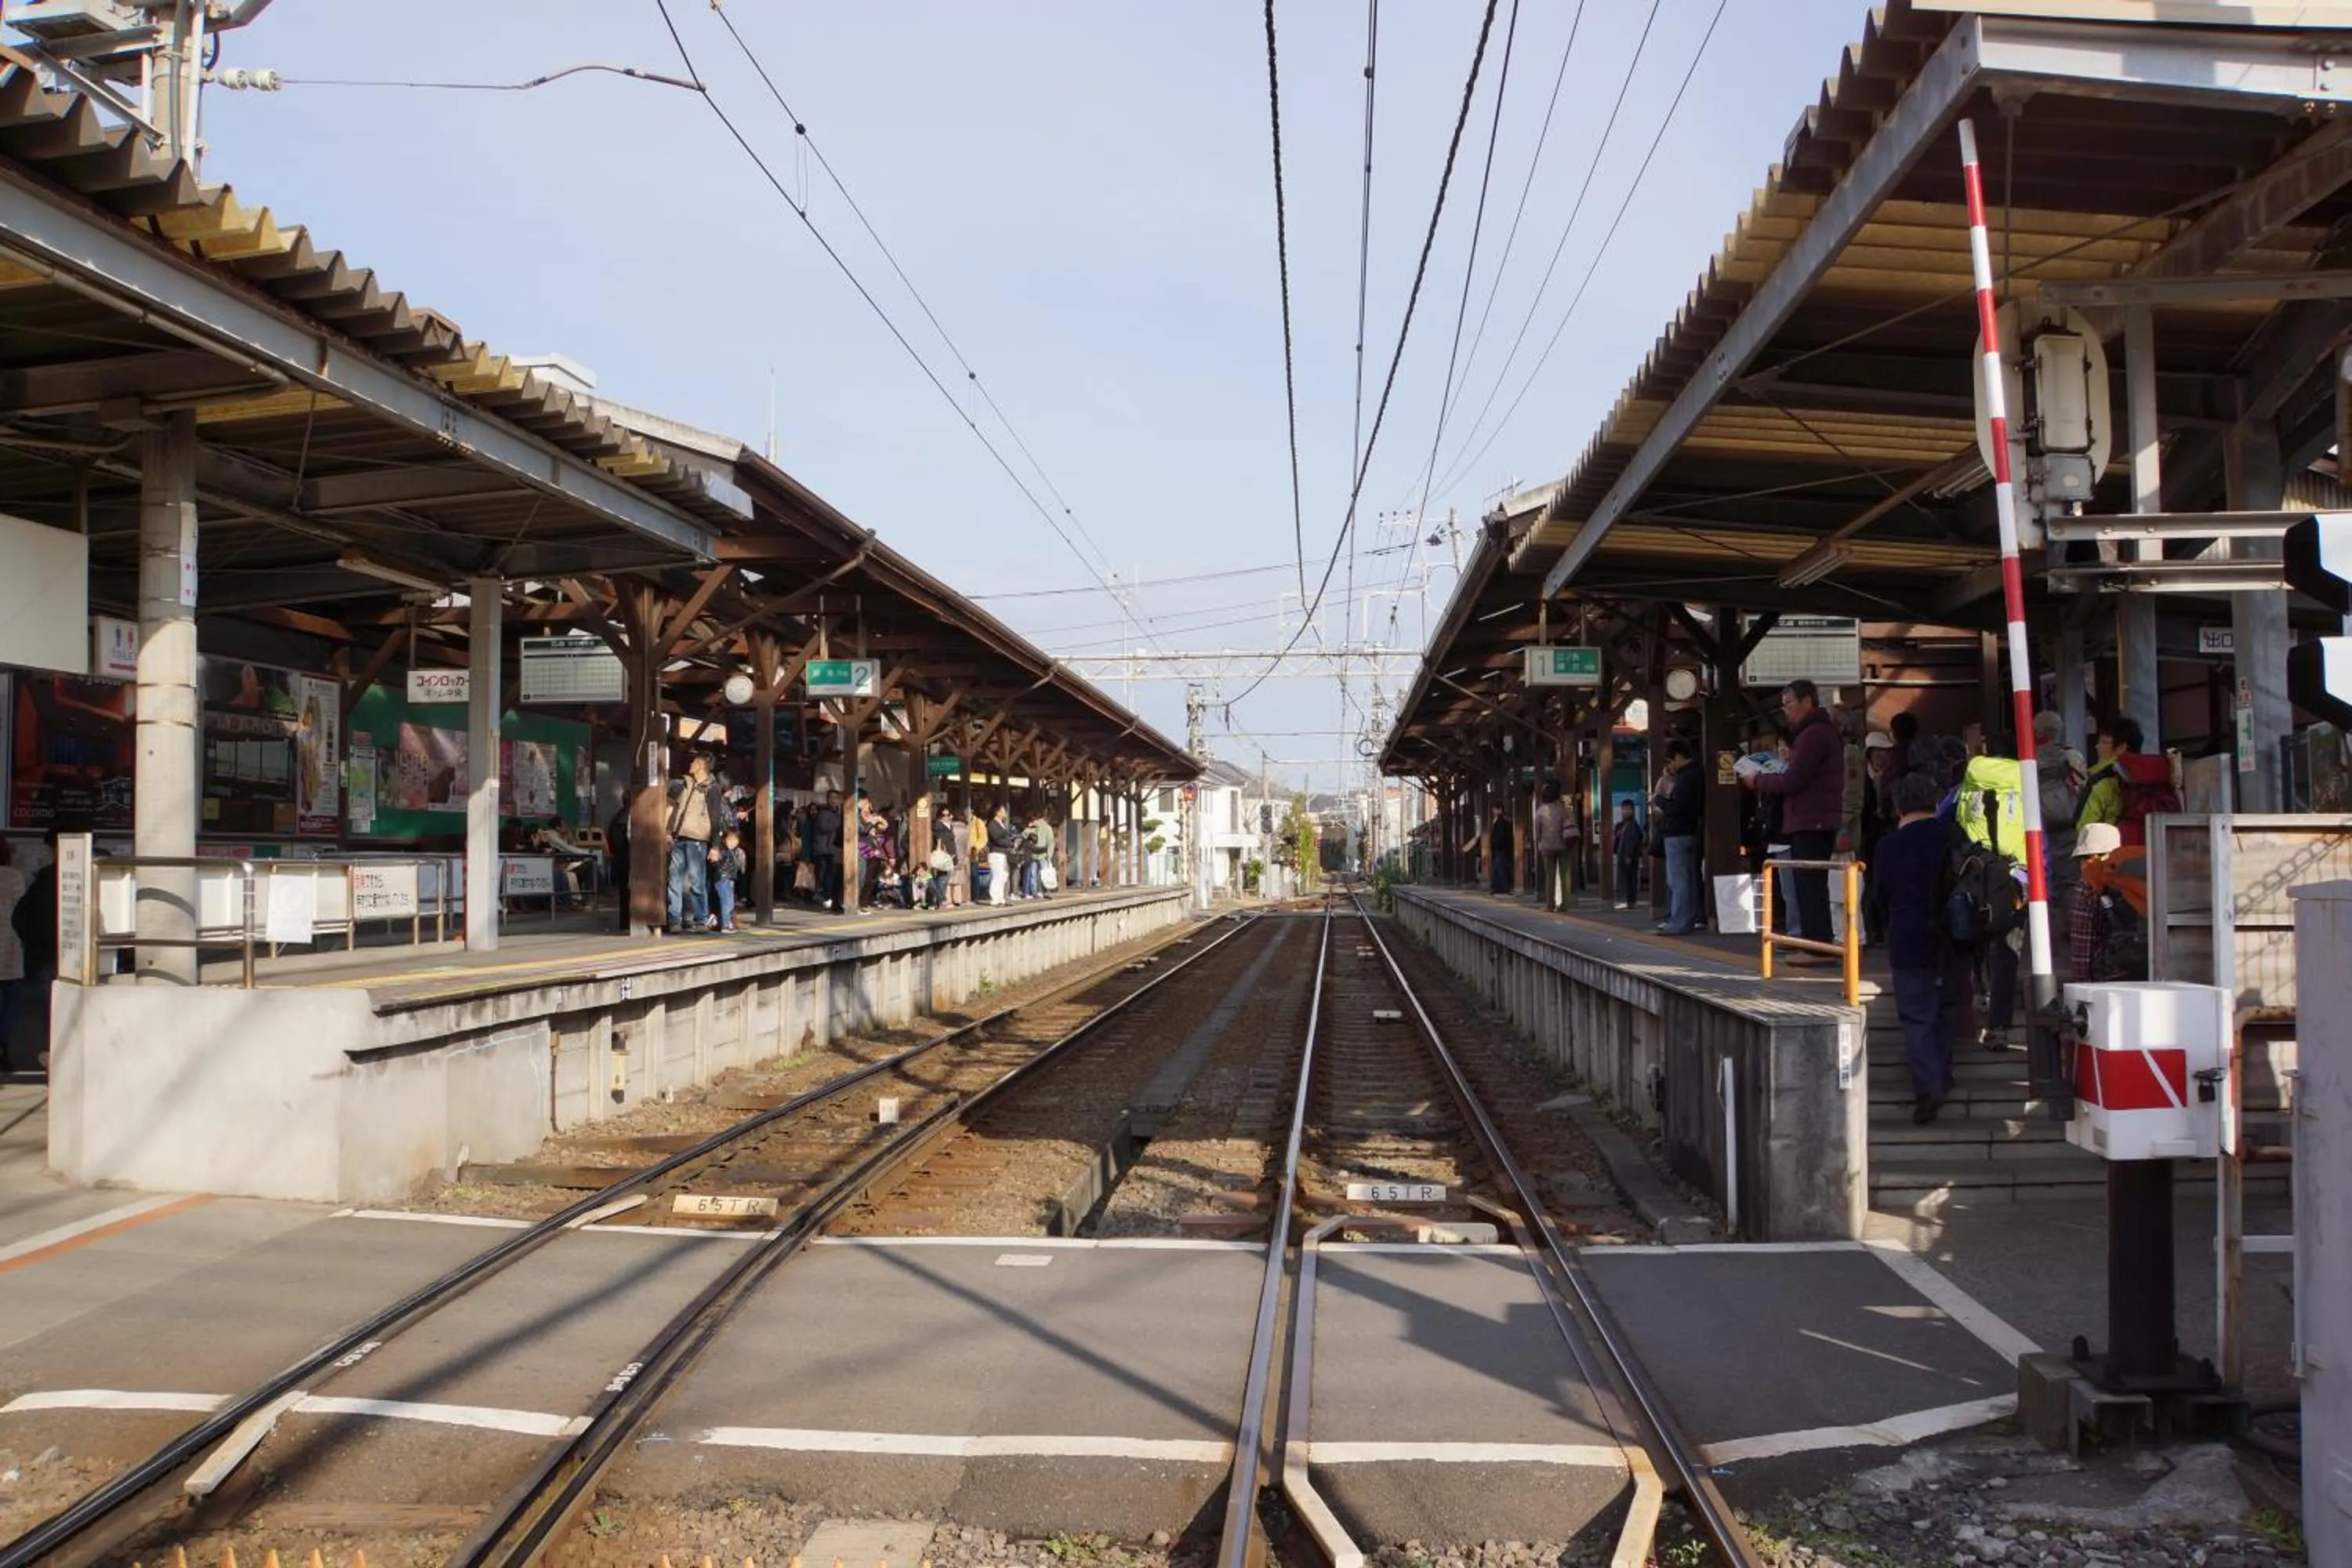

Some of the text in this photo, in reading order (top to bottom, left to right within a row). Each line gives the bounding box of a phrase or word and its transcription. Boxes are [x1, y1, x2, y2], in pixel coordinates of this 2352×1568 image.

[2205, 632, 2234, 648] 出口
[1538, 655, 1545, 677] 1
[416, 675, 470, 687] コインロッカー
[855, 666, 868, 688] 2
